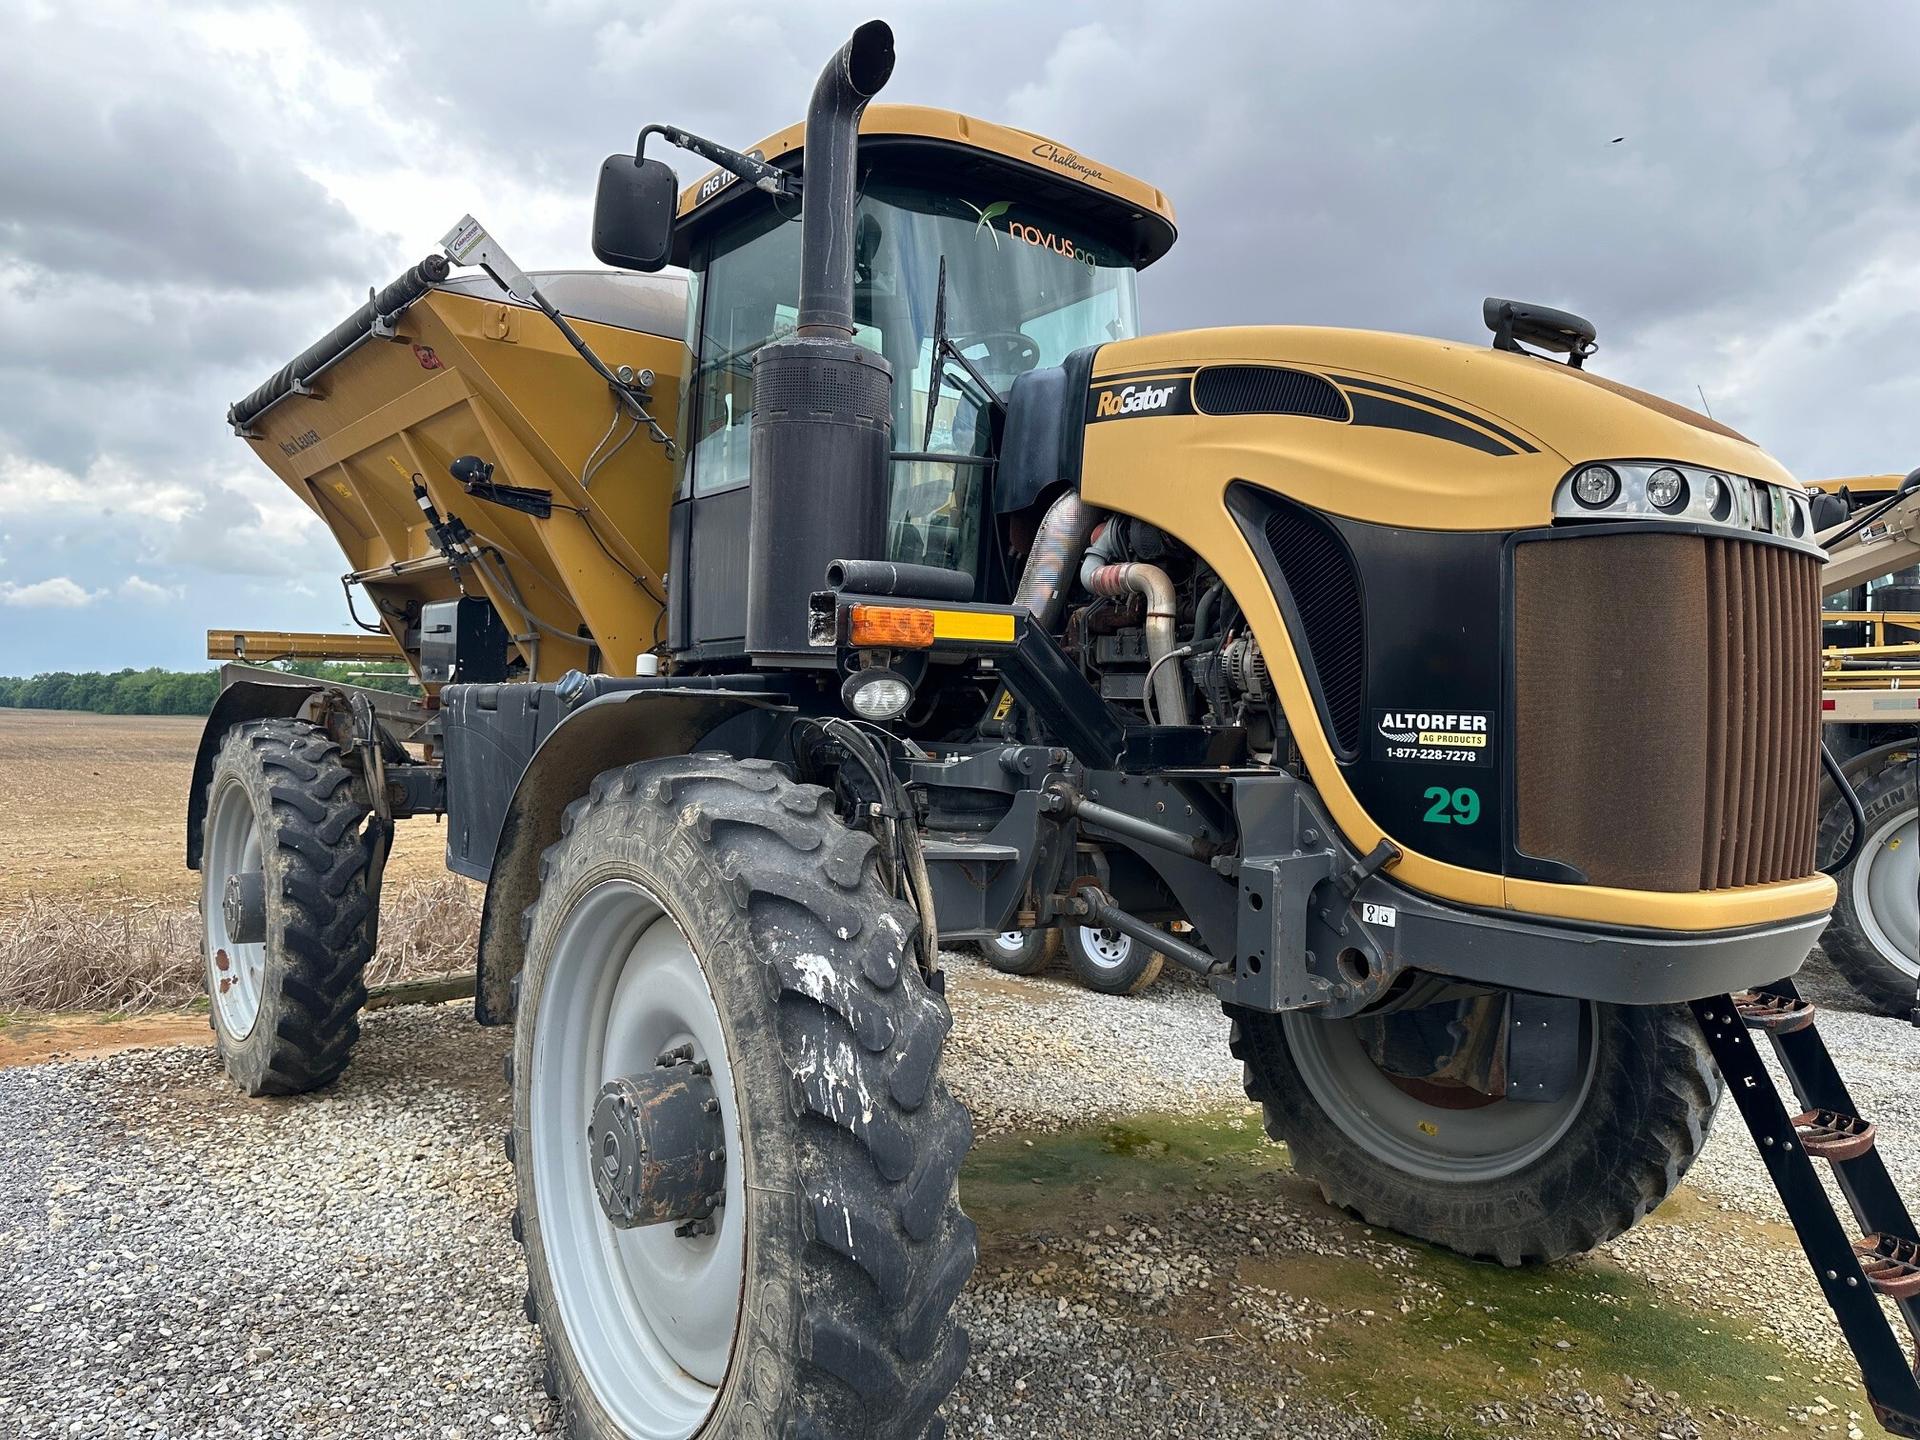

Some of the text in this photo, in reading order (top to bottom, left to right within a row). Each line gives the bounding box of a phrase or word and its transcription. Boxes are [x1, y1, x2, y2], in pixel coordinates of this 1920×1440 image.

[1032, 143, 1113, 184] Challenger
[702, 176, 720, 198] RG
[1096, 386, 1174, 417] RoGator
[1382, 713, 1487, 731] ALTORFER
[1437, 735, 1482, 744] PRODUCTS
[1386, 747, 1476, 762] 1-877-228-7278
[1423, 786, 1480, 825] 29
[1831, 787, 1906, 861] MICELIN
